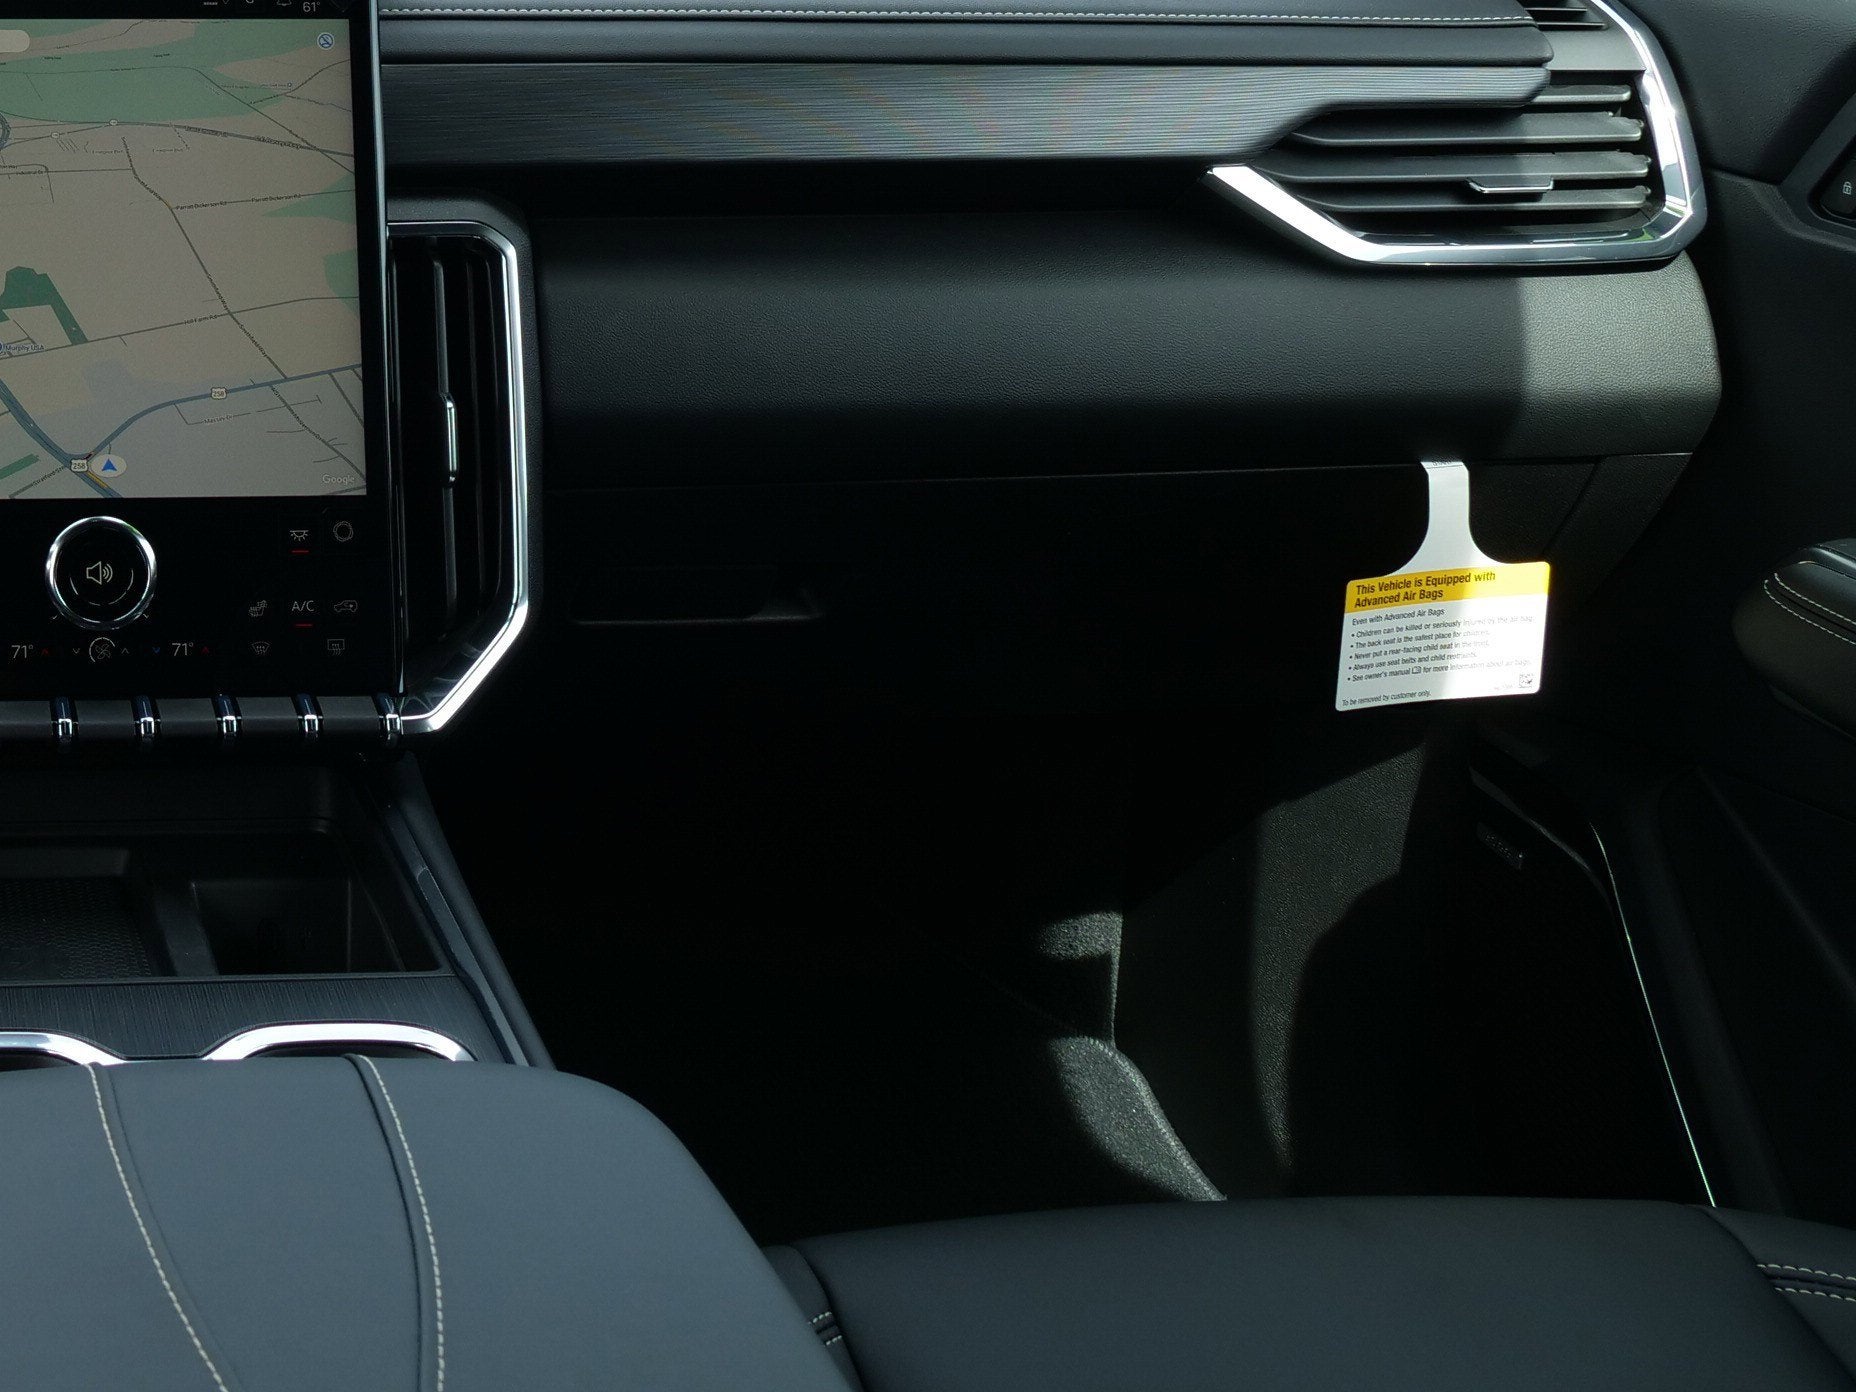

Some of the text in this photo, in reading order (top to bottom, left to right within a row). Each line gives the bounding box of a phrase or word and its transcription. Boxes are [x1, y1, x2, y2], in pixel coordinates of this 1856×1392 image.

[302, 1, 321, 12] 61°
[322, 474, 355, 484] Google
[1356, 572, 1496, 595] This Vehicle is Equipped with
[291, 600, 315, 612] A/C
[1355, 589, 1443, 608] Advanced Air Bags
[1352, 608, 1445, 626] Even with Advanced Air Bags
[1356, 629, 1381, 638] Children
[1405, 623, 1422, 631] killed
[1433, 620, 1461, 628] seriously
[1368, 639, 1381, 647] back
[1435, 632, 1452, 641] place
[10, 644, 34, 659] 71°
[171, 642, 194, 656] 71°
[1354, 652, 1371, 660] Never
[1373, 650, 1382, 658] put
[1389, 645, 1422, 655] rear-facing
[1423, 643, 1438, 651] child
[1353, 662, 1374, 671] Always
[1387, 658, 1400, 667] seat
[1402, 656, 1416, 664] belts
[1418, 655, 1429, 663] and
[1431, 653, 1445, 661] child
[1352, 674, 1364, 682] See
[1365, 671, 1387, 680] owner's
[1389, 668, 1411, 677] manual
[1358, 695, 1381, 704] removed
[1391, 691, 1417, 700] customer
[1418, 689, 1431, 697] only.
